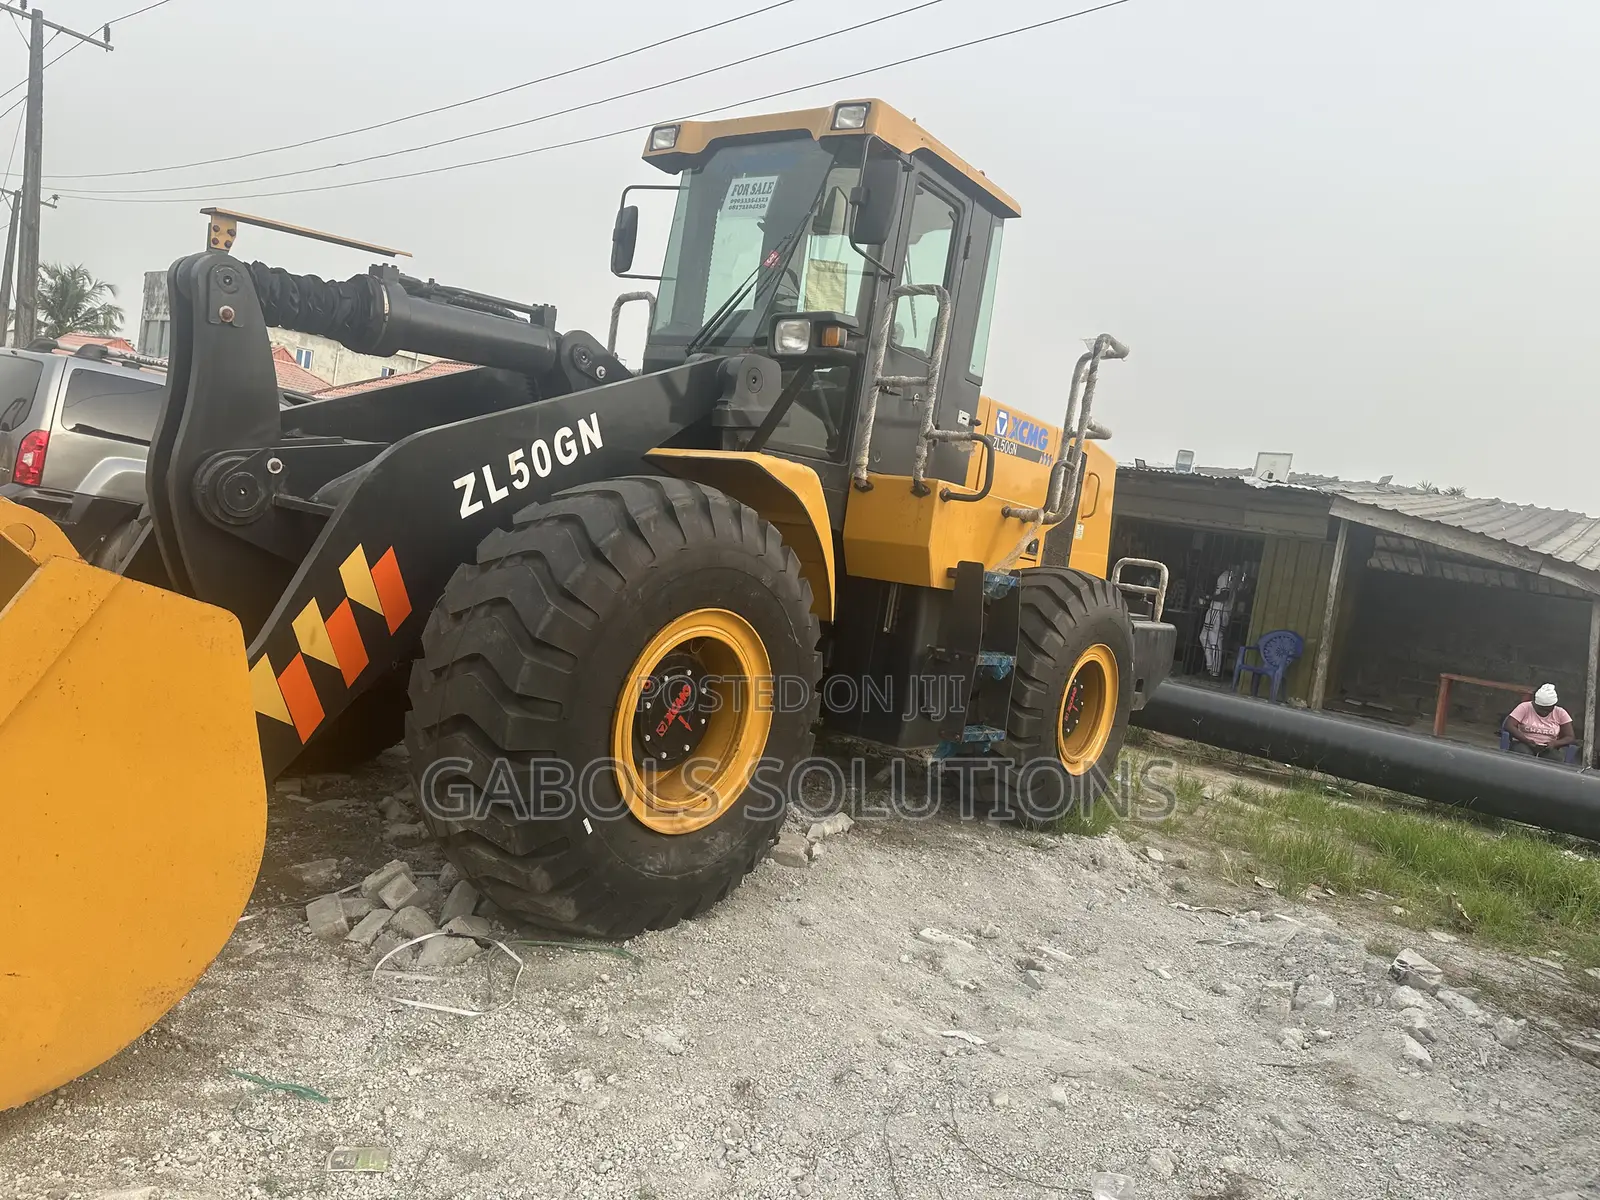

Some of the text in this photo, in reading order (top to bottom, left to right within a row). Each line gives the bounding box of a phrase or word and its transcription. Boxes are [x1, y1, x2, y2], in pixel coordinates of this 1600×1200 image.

[731, 181, 774, 196] FOR SALE
[992, 436, 1018, 456] ZL50GN
[1008, 416, 1049, 451] XCMG
[452, 412, 604, 520] ZL50GN
